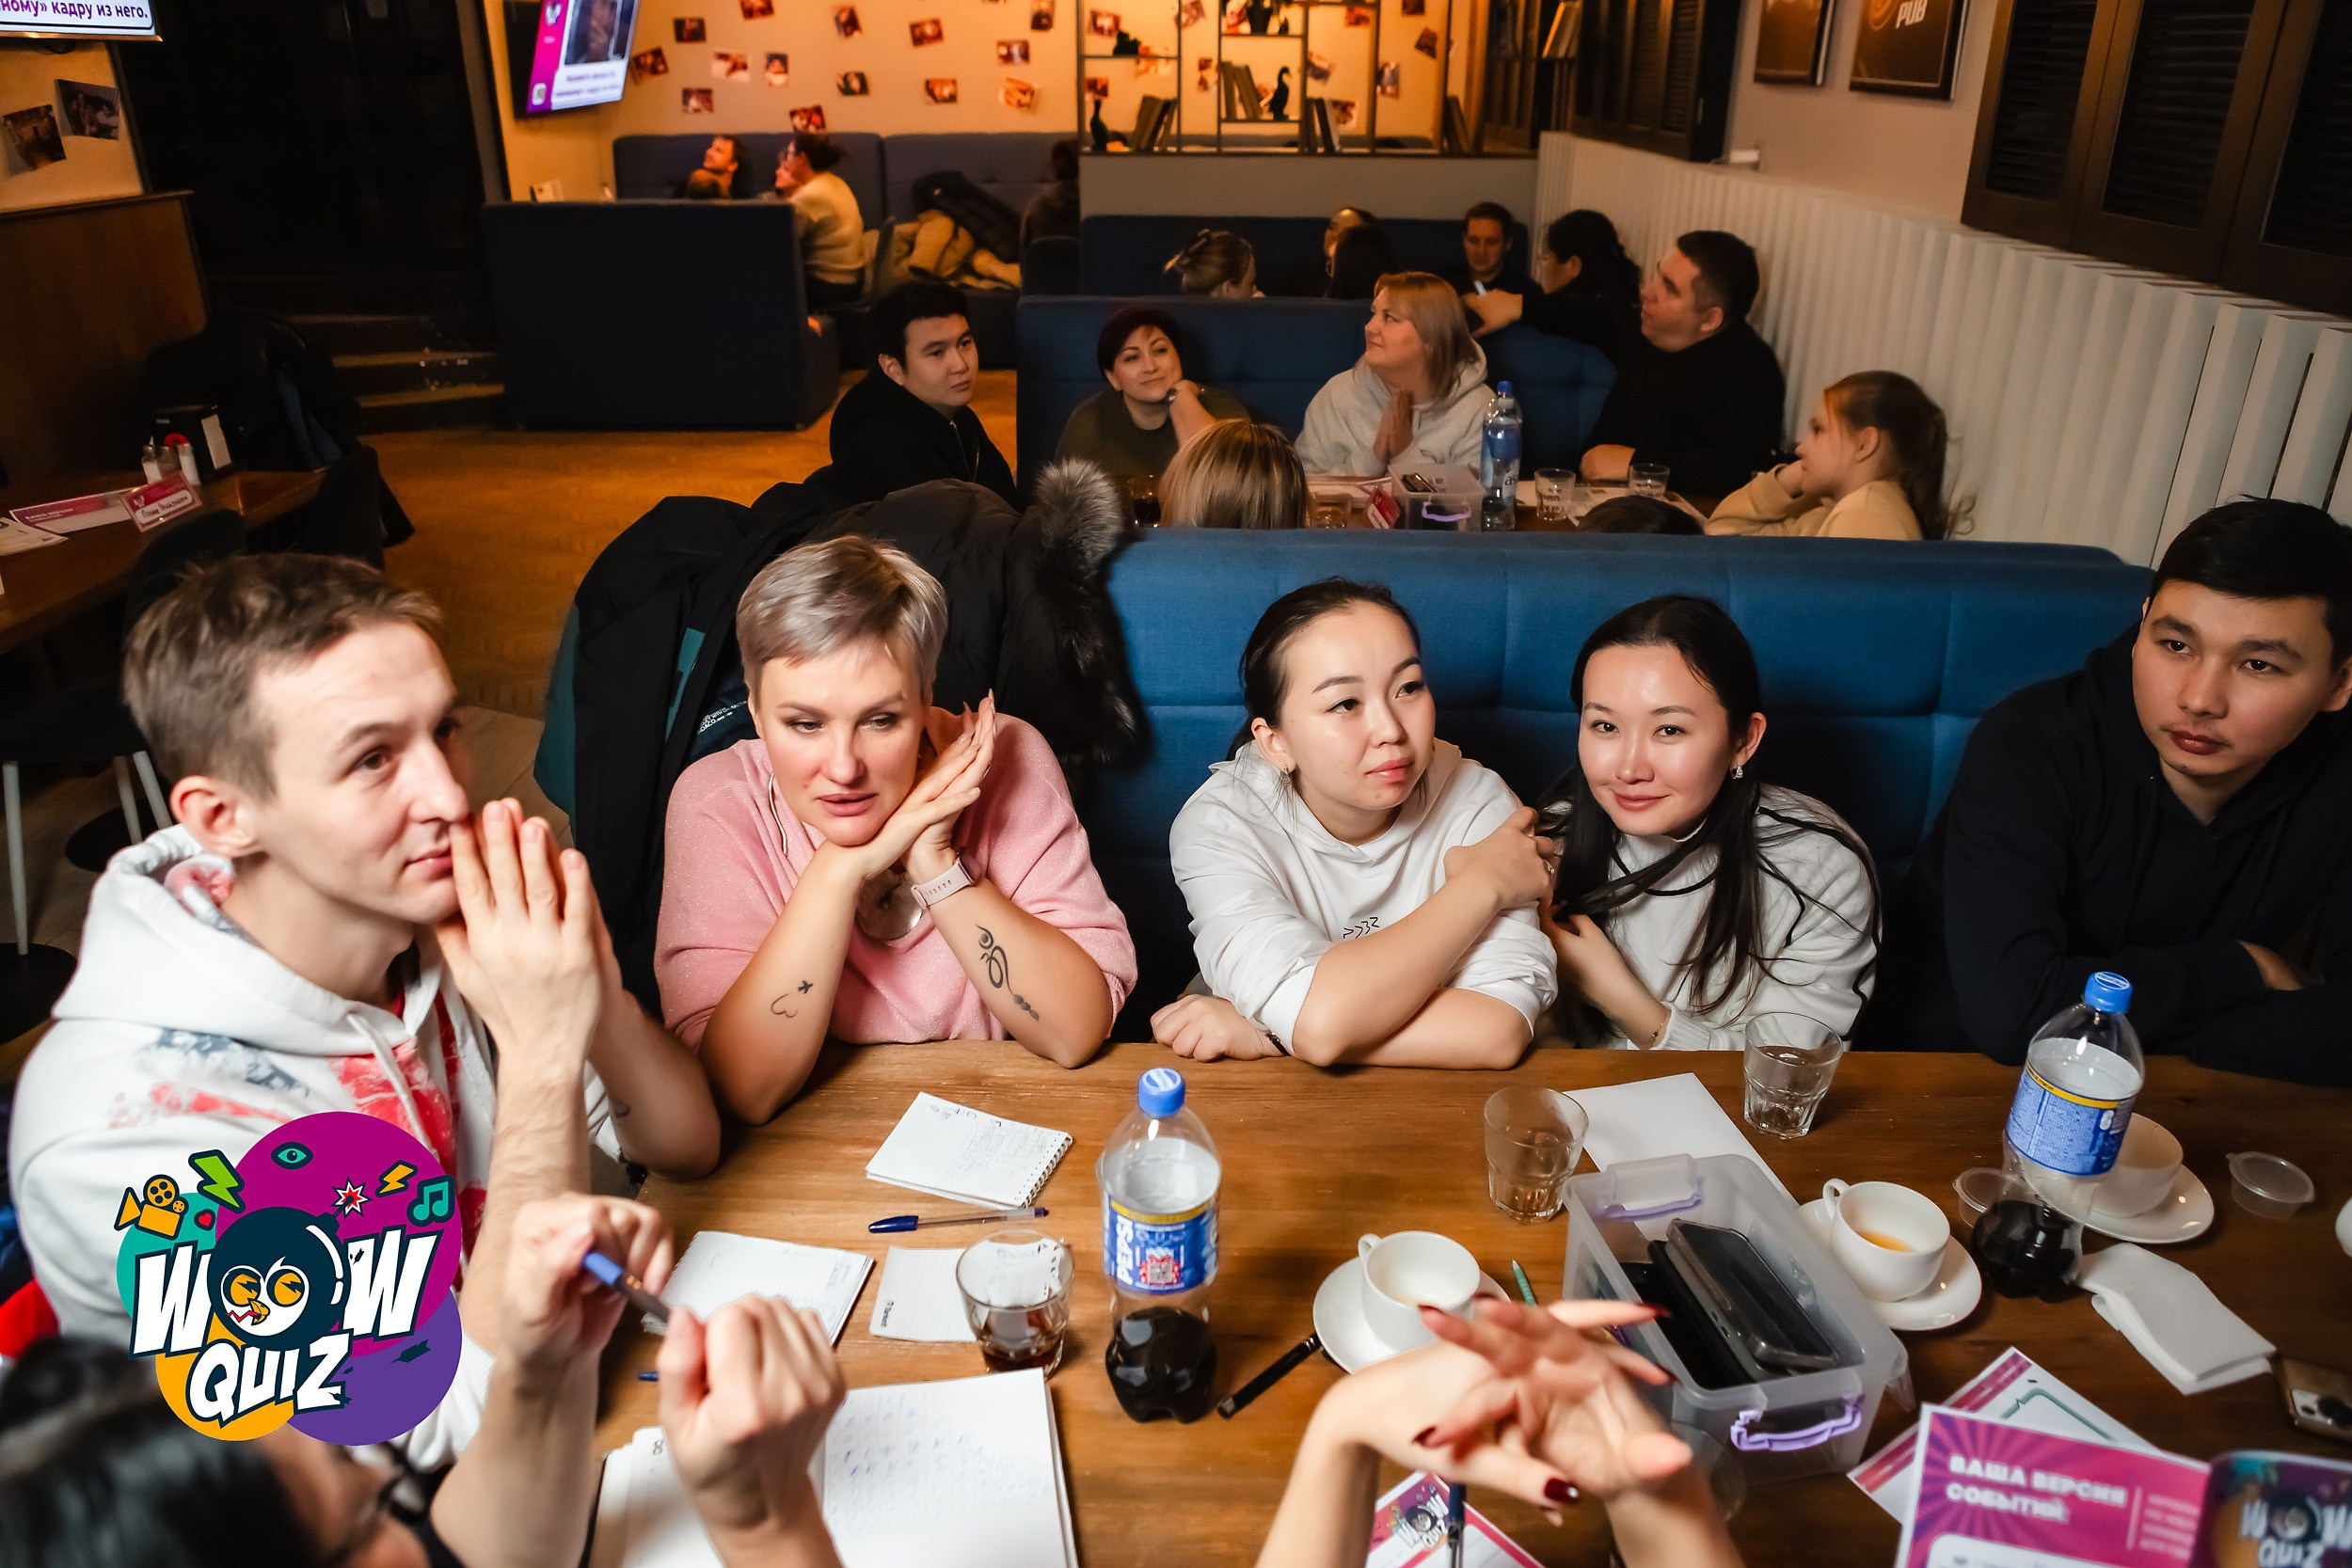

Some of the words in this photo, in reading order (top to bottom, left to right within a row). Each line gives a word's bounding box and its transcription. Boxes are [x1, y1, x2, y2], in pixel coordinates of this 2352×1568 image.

[0, 0, 47, 17] ному»
[52, 1, 92, 19] кадру
[97, 4, 112, 17] из
[115, 5, 148, 19] него.
[1117, 1214, 1134, 1285] PEPSI
